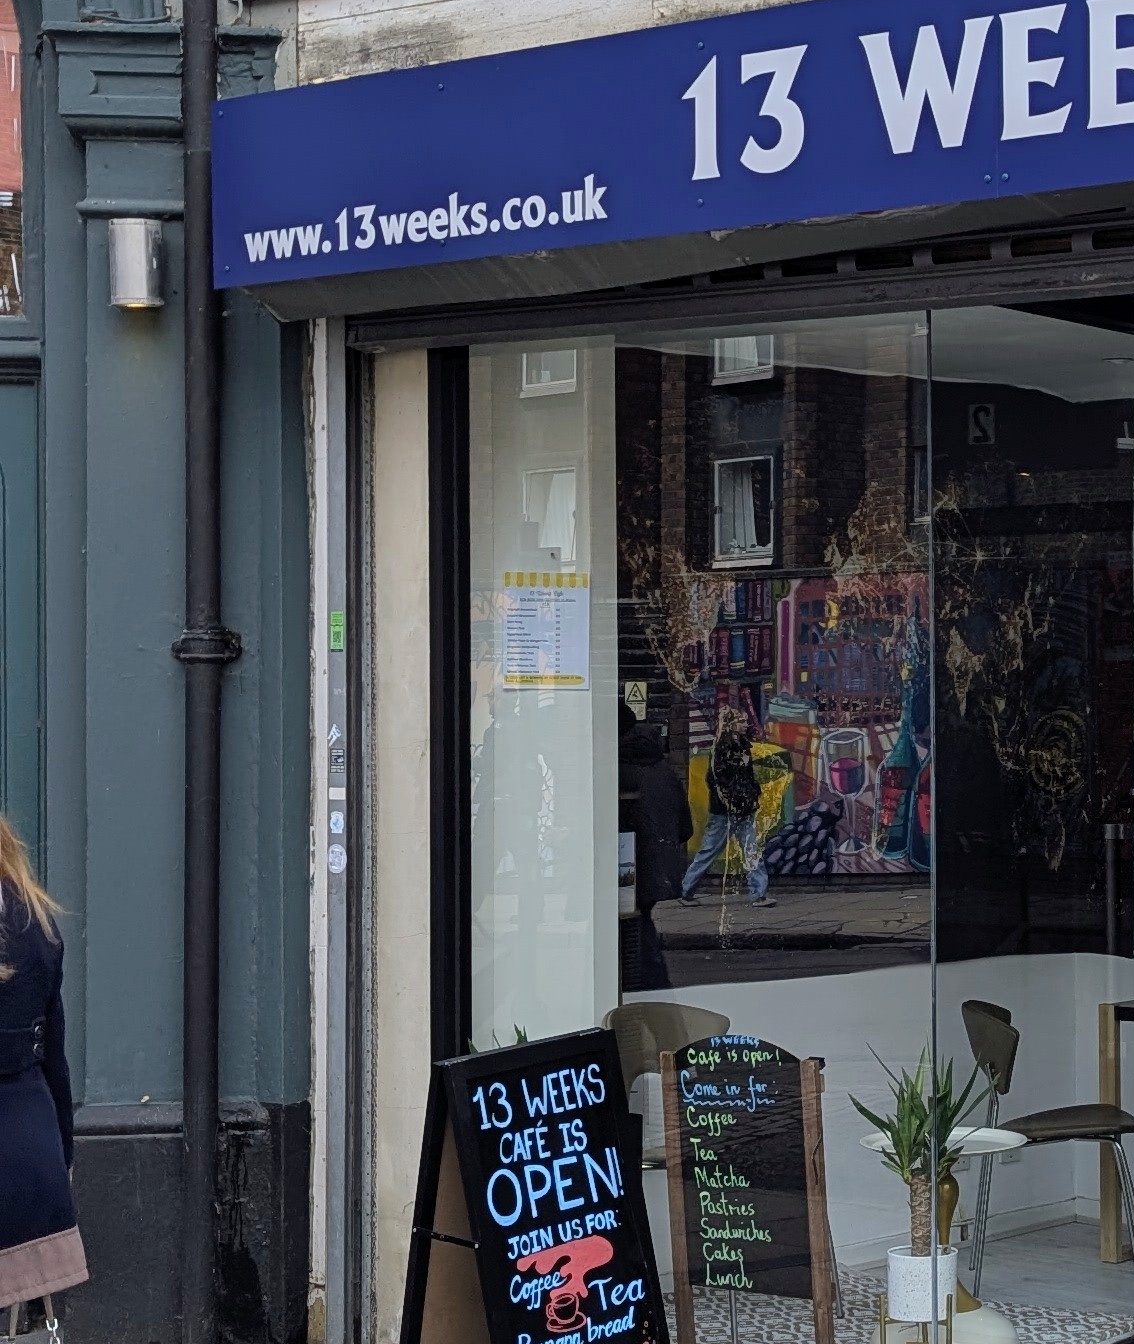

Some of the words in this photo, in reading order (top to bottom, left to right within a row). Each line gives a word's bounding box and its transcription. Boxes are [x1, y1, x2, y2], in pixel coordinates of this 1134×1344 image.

[681, 44, 808, 180] 13
[244, 173, 608, 263] www.13weeks.co.uk
[687, 1047, 721, 1071] Cafe
[727, 1049, 738, 1063] is
[472, 1082, 513, 1130] 13
[521, 1063, 606, 1117] WEEKS
[680, 1069, 721, 1098] Come
[725, 1078, 741, 1096] in
[687, 1105, 737, 1136] Coffee
[500, 1119, 551, 1164] CAFÉ
[559, 1118, 588, 1154] IS
[690, 1137, 718, 1161] Tea
[487, 1146, 625, 1227] OPEN!
[694, 1164, 750, 1188] Matcha
[699, 1191, 755, 1216] Pastries
[508, 1225, 554, 1260] JOIN
[557, 1218, 584, 1243] US
[700, 1217, 772, 1242] Sandwiches
[702, 1242, 744, 1262] Cakes
[706, 1261, 753, 1289] Lunch
[509, 1271, 567, 1310] Coffee
[588, 1276, 646, 1311] Tea
[586, 1305, 636, 1342] bread
